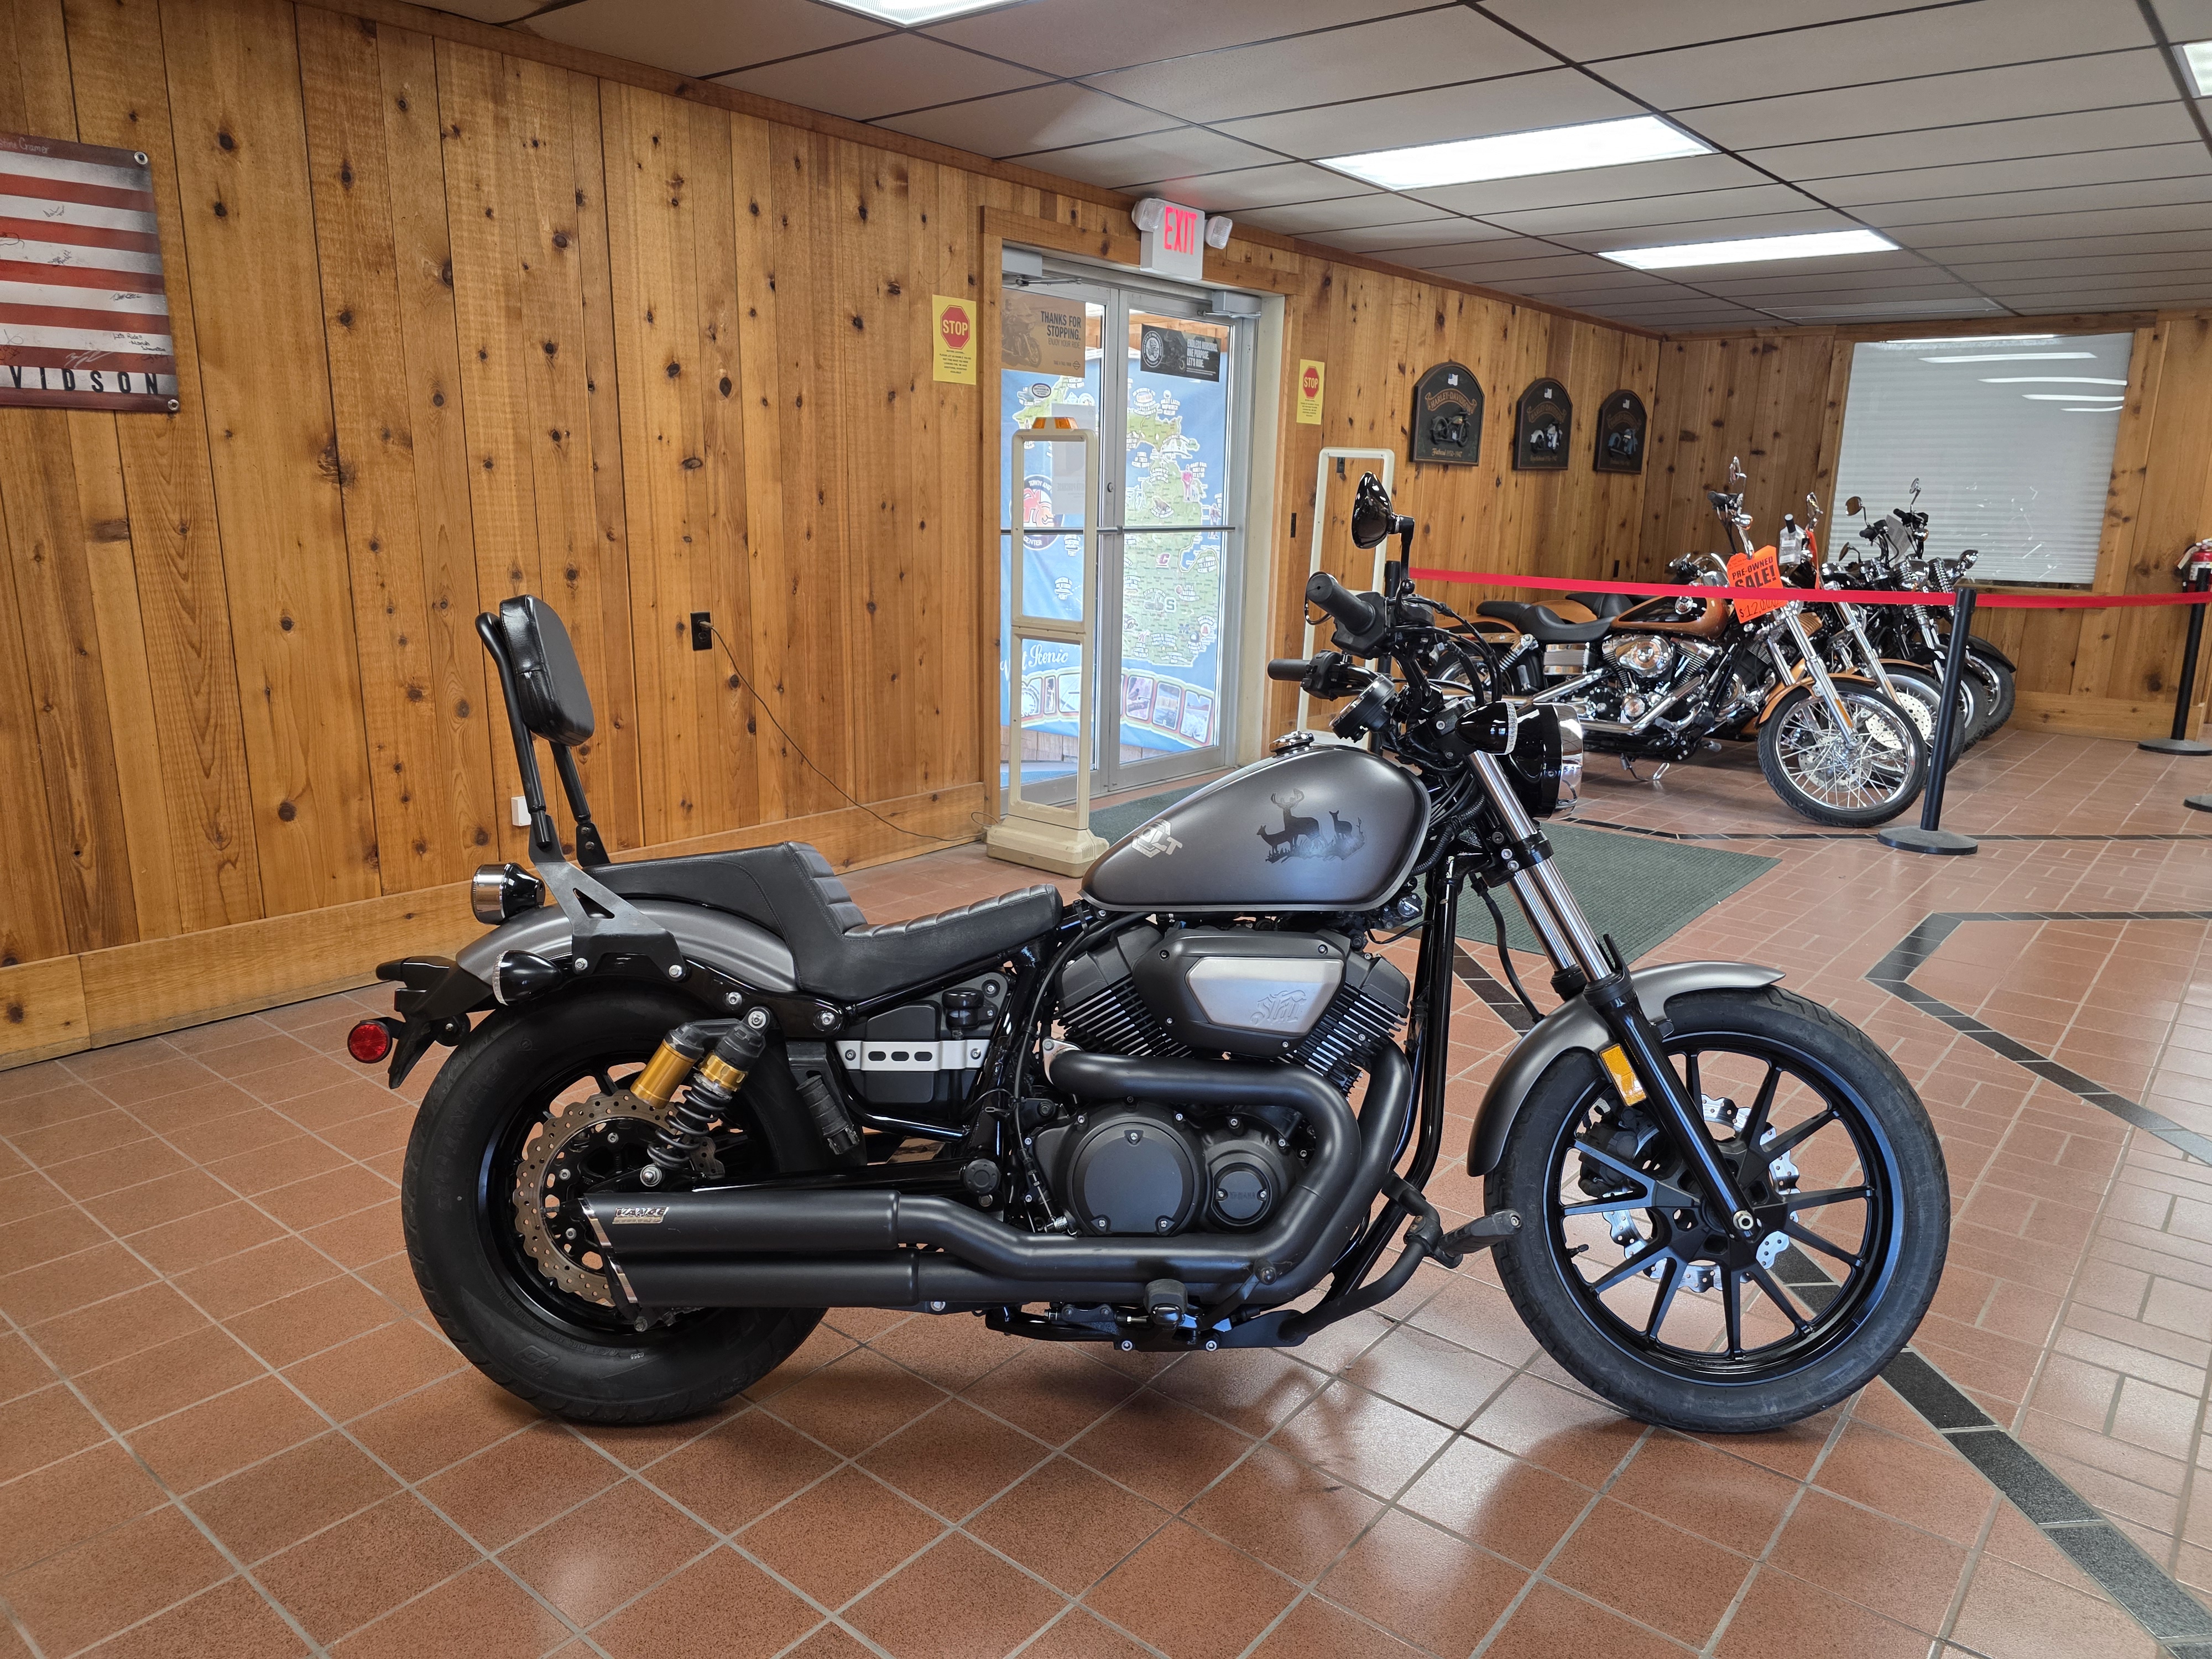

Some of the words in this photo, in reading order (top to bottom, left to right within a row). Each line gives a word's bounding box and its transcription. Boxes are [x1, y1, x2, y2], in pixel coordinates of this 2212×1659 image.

[1164, 206, 1197, 255] EXIT
[942, 319, 968, 336] STOP
[1041, 311, 1067, 326] THANKS
[1069, 315, 1082, 328] FOR
[1047, 325, 1081, 341] STOPPING.
[1048, 337, 1060, 347] ENJOY
[1060, 339, 1071, 347] YOUR
[1186, 357, 1196, 367] LET'S
[8, 365, 159, 395] VIDSON
[1304, 377, 1318, 388] STOP
[1732, 556, 1773, 580] PRE-OWNED
[1735, 565, 1776, 588] SALE!
[1029, 644, 1069, 667] Scenic
